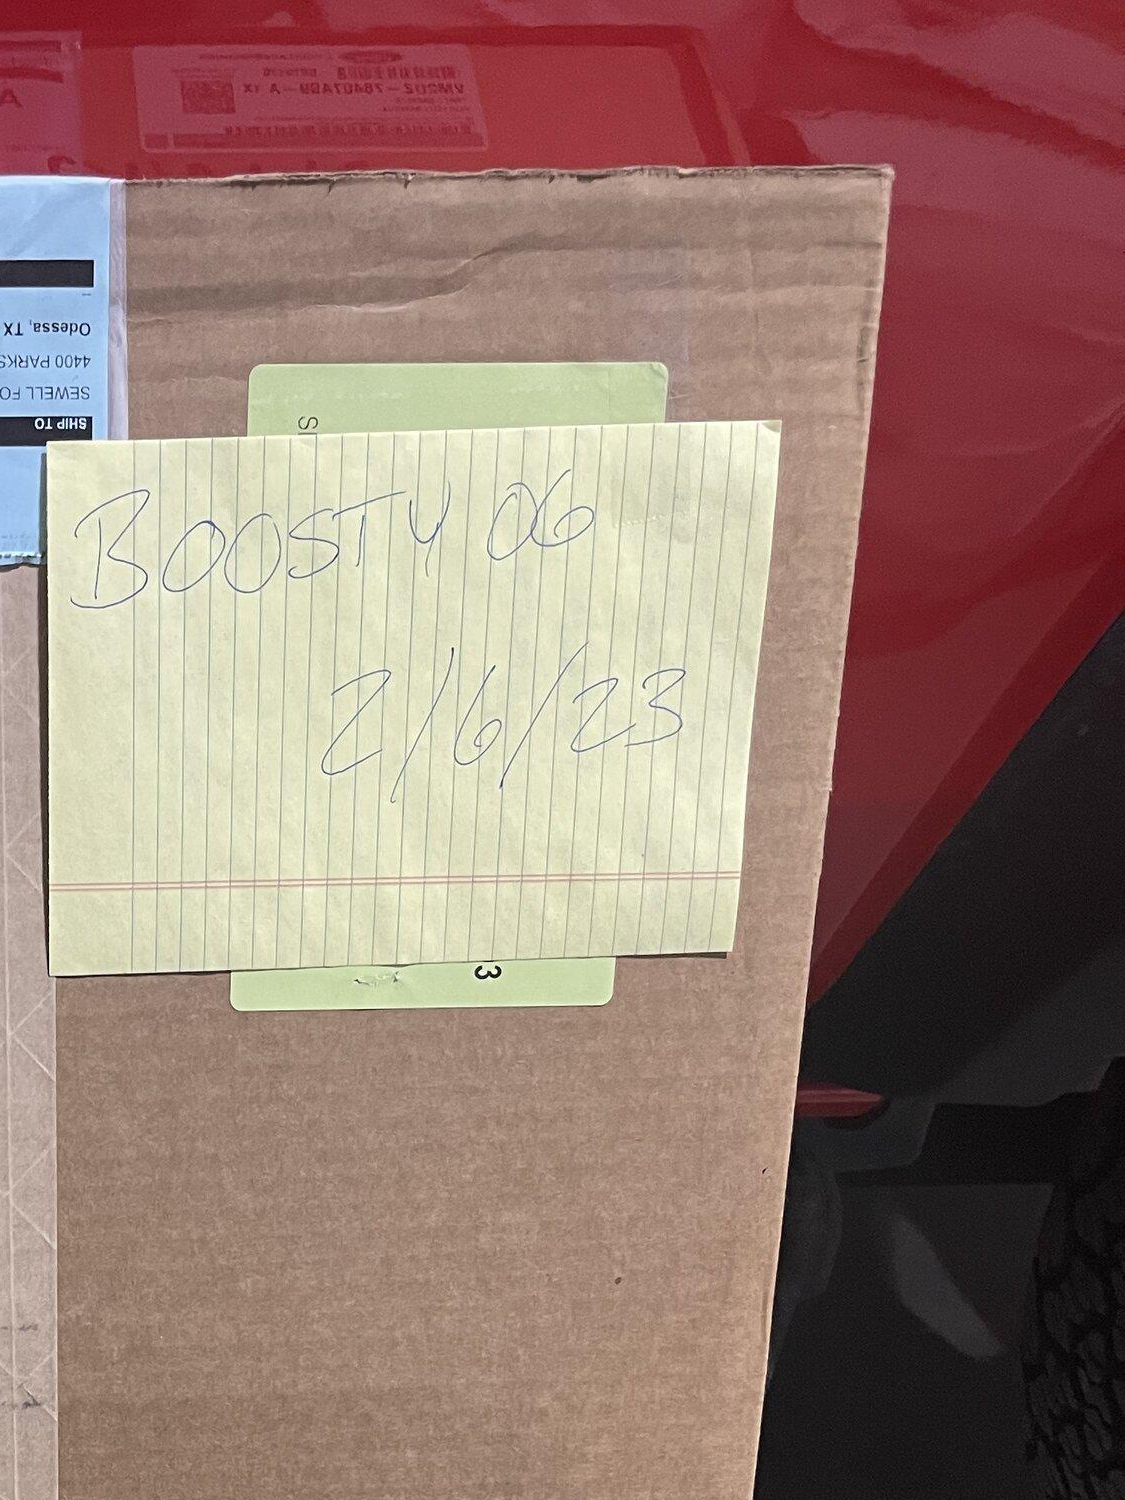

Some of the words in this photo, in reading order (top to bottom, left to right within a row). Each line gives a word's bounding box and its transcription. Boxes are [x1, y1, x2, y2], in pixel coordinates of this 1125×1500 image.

[4, 322, 24, 336] TX
[29, 320, 91, 336] Odessa,
[55, 354, 92, 368] 4400
[25, 385, 90, 400] SEWELL
[33, 417, 52, 430] TO
[55, 417, 87, 430] SHIP
[320, 642, 687, 804] 2/6/23
